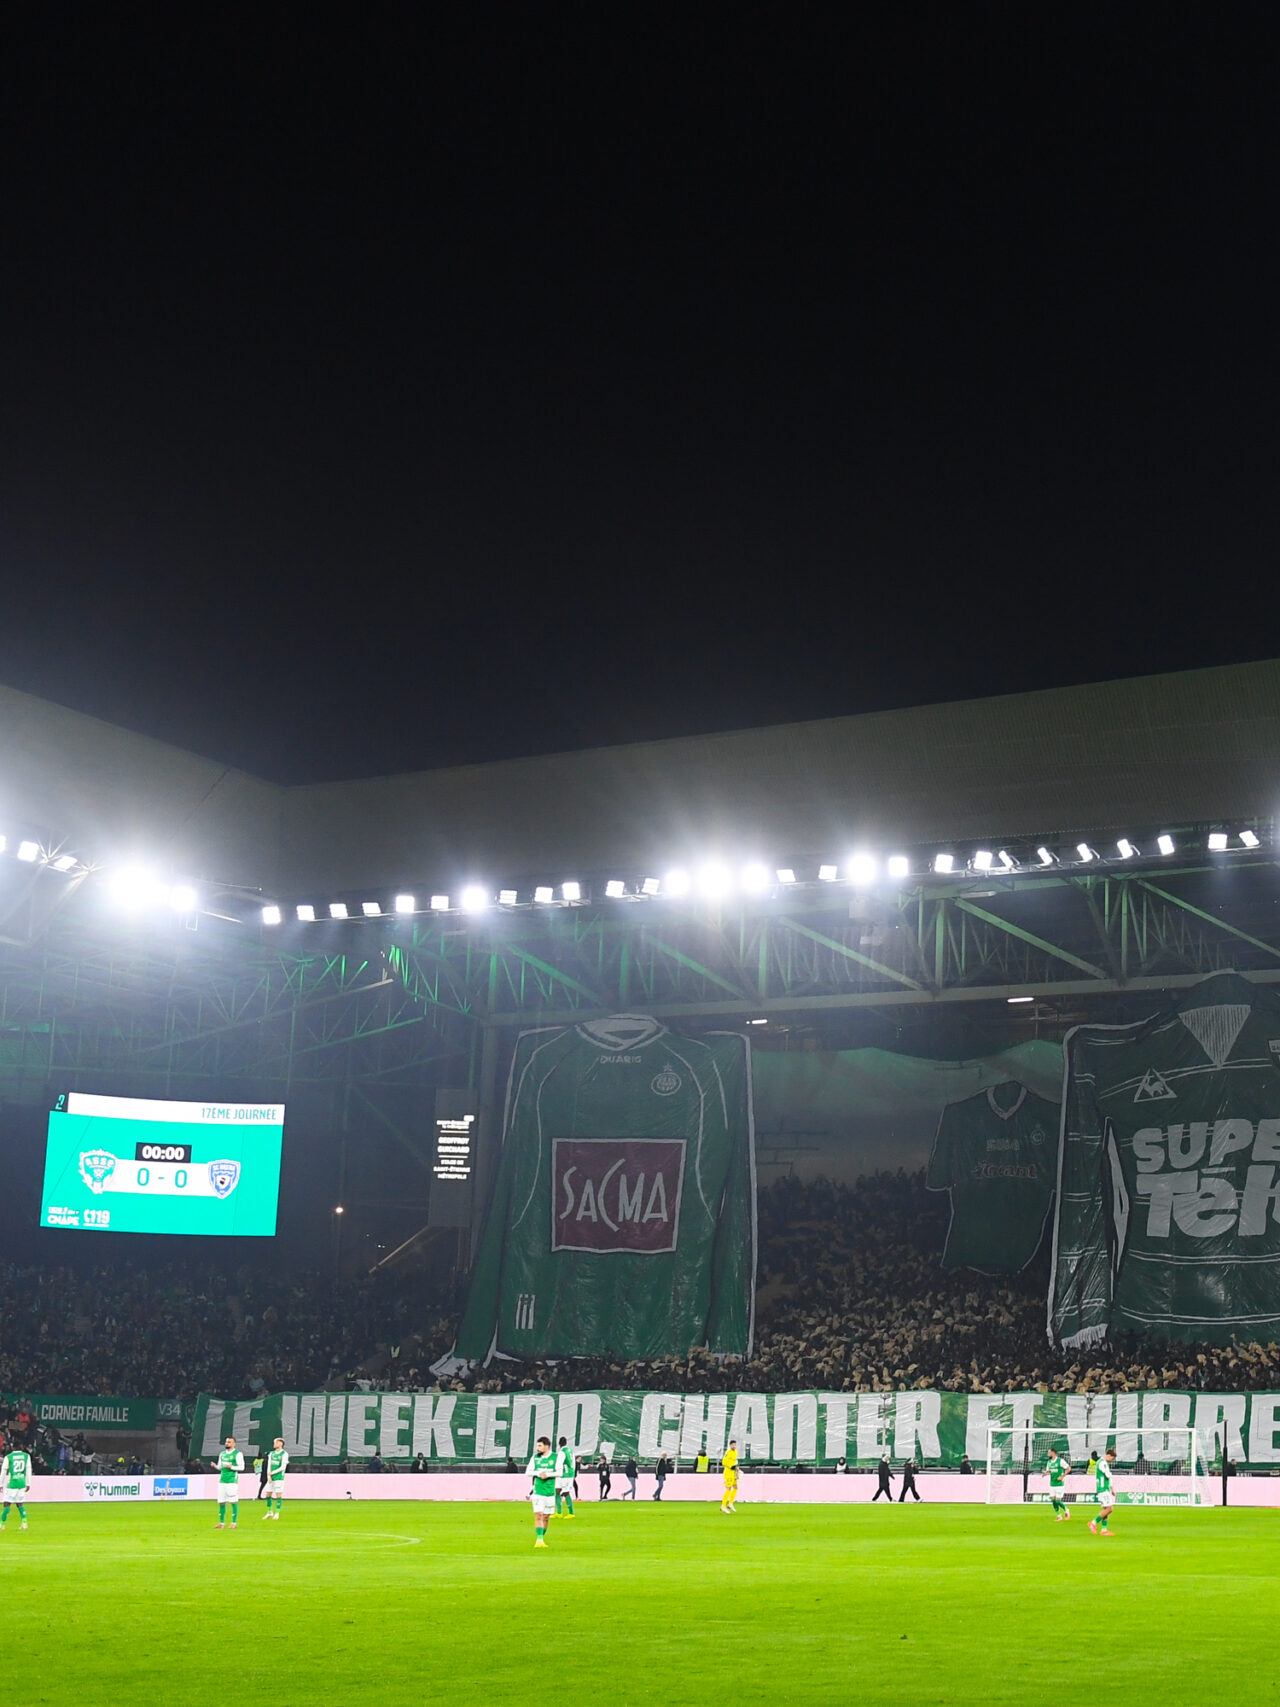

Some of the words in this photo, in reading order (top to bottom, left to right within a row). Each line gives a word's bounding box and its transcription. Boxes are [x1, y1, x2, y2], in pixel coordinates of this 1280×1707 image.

[141, 1145, 185, 1160] 00:00
[137, 1168, 150, 1186] 0
[174, 1169, 188, 1188] 0
[560, 1158, 668, 1232] SACMA
[41, 1404, 84, 1421] CORNER
[86, 1407, 129, 1422] FAMILLE
[159, 1403, 182, 1416] V34
[201, 1399, 265, 1457] LE
[638, 1391, 941, 1460] CHANTER
[965, 1393, 1043, 1461] ET
[100, 1482, 140, 1496] hummel
